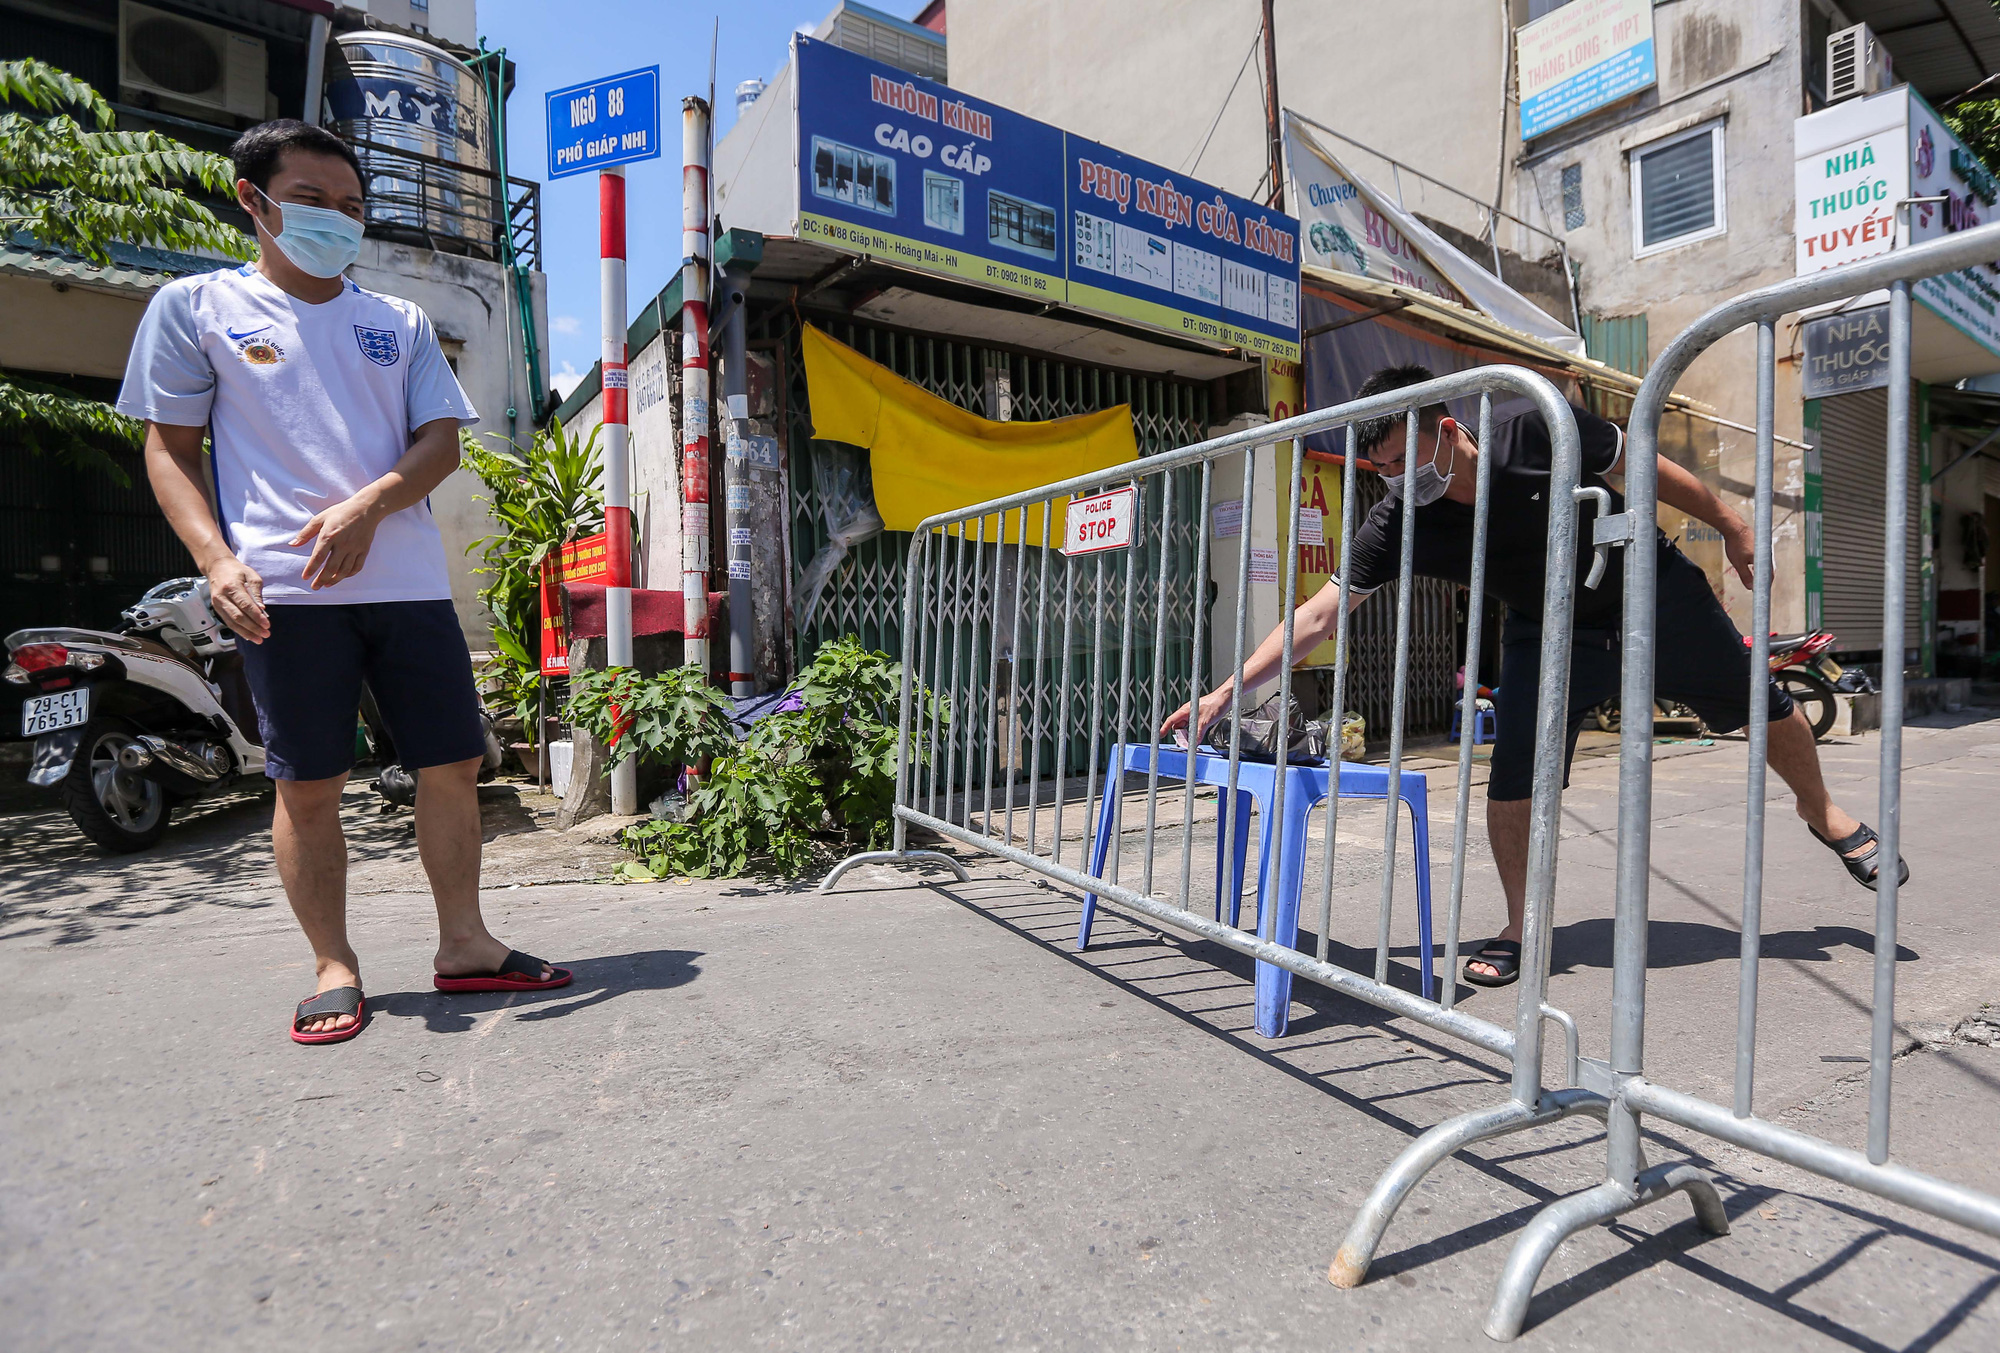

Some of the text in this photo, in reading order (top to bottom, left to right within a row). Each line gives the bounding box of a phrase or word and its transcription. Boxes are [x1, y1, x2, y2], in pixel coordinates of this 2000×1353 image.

[1569, 35, 1601, 68] LONG
[1612, 14, 1640, 45] MPT
[363, 86, 441, 129] MỸ
[570, 87, 624, 128] NGÕ 88
[871, 73, 992, 141] NHÔM KÍNH
[557, 130, 647, 165] PHỐ GIÁP NHỊ
[874, 123, 991, 175] CAO CẤP
[1079, 158, 1293, 263] PHỤ KIỆN CỬA KÍNH
[1809, 175, 1887, 219] THUỐC
[803, 219, 820, 233] ĐC:
[850, 230, 870, 248] Giáp
[872, 236, 887, 253] Nhị
[895, 242, 922, 261] Hoàng
[924, 249, 939, 262] Mai
[946, 255, 958, 267] HN
[1803, 207, 1893, 257] TUYẾT
[986, 265, 999, 278] ĐT:
[1001, 269, 1018, 283] 0902
[1020, 274, 1032, 286] 181
[1183, 317, 1197, 330] ĐT:
[1199, 321, 1217, 336] 0979
[1219, 328, 1232, 340] 101
[1234, 332, 1248, 344] 090
[1254, 337, 1270, 350] 0977
[1272, 343, 1284, 355] 262
[1285, 347, 1297, 358] 871
[1838, 369, 1869, 385] GIÁP
[1872, 368, 1890, 379] NH
[748, 440, 771, 464] 64
[1085, 499, 1112, 514] POLICE
[1079, 517, 1116, 541] STOP
[28, 707, 82, 733] 765.51
[34, 692, 78, 715] 29-C1
